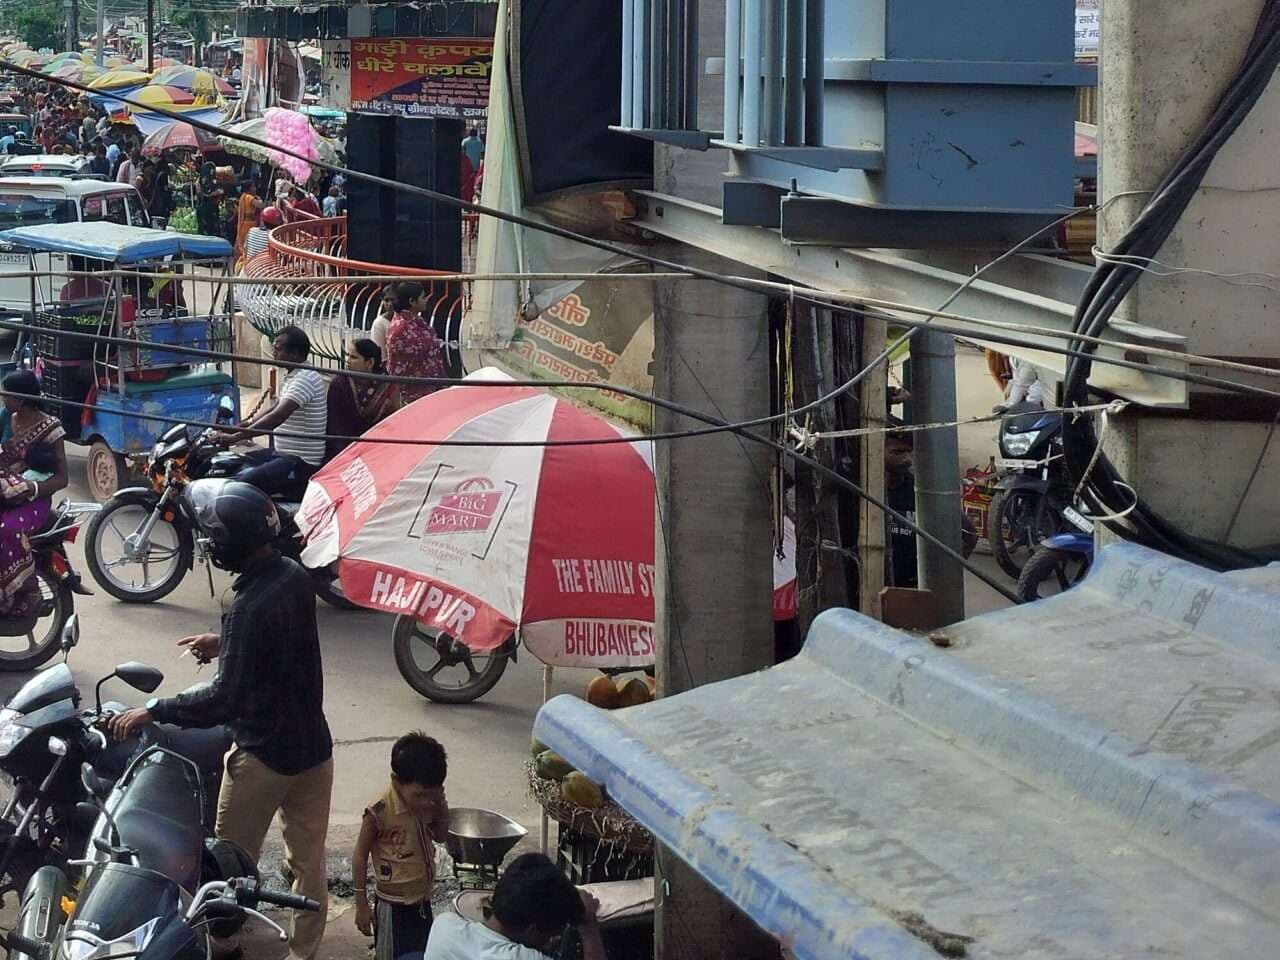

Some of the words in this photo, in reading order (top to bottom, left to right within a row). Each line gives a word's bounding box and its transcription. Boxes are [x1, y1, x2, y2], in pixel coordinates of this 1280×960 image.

[353, 40, 410, 58] गाड़ी
[356, 57, 396, 73] धीरे
[430, 512, 481, 529] MART
[551, 559, 583, 593] THE
[584, 559, 636, 595] FAMILY
[370, 570, 476, 635] HAJIPUR
